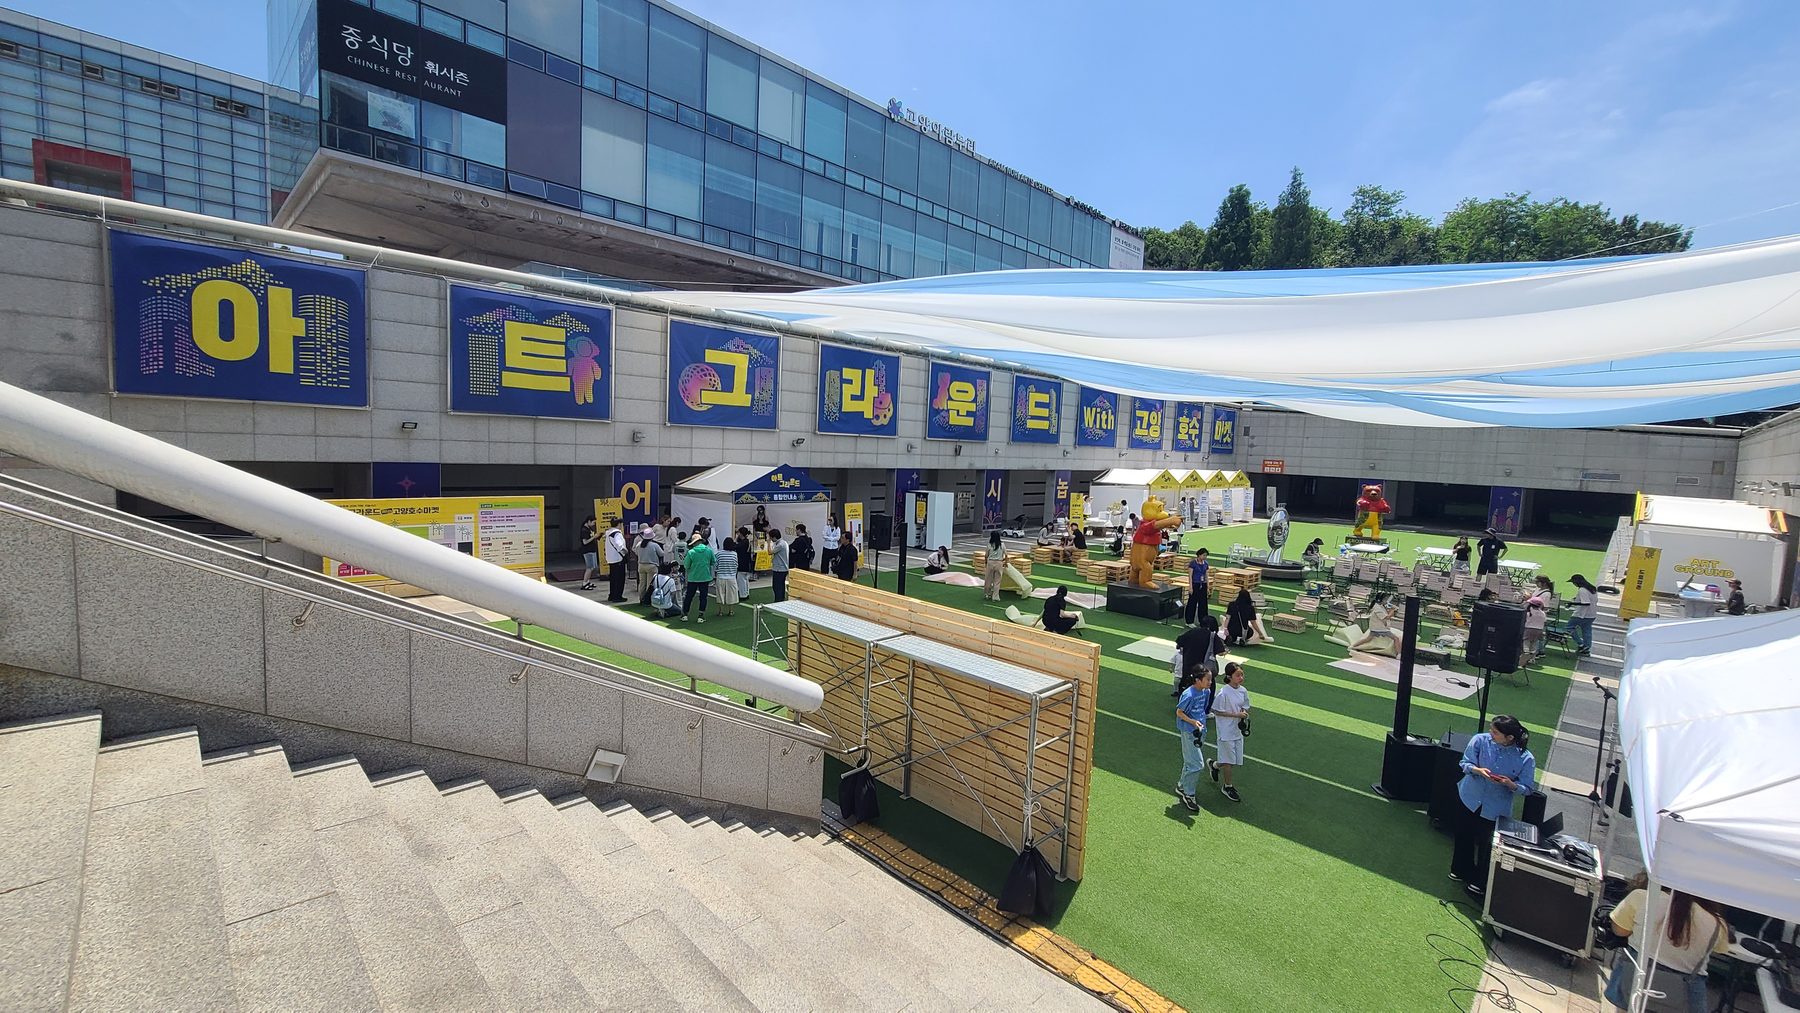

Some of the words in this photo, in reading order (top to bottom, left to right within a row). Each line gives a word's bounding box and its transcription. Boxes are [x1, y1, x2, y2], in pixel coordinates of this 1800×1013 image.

[341, 24, 414, 67] 중식당
[347, 55, 391, 75] CHINESE
[191, 280, 308, 374] 아
[501, 321, 571, 392] 트
[700, 348, 752, 407] 그
[843, 368, 880, 420] 라
[948, 381, 977, 427] 운
[1027, 392, 1051, 430] 드
[1084, 406, 1115, 430] With
[1135, 409, 1163, 439] 고양
[1177, 416, 1200, 448] 호수
[1214, 420, 1233, 444] 마켓
[620, 479, 651, 516] 어
[987, 478, 1002, 502] 시
[1673, 564, 1735, 579] GROUND
[1690, 558, 1720, 568] ART
